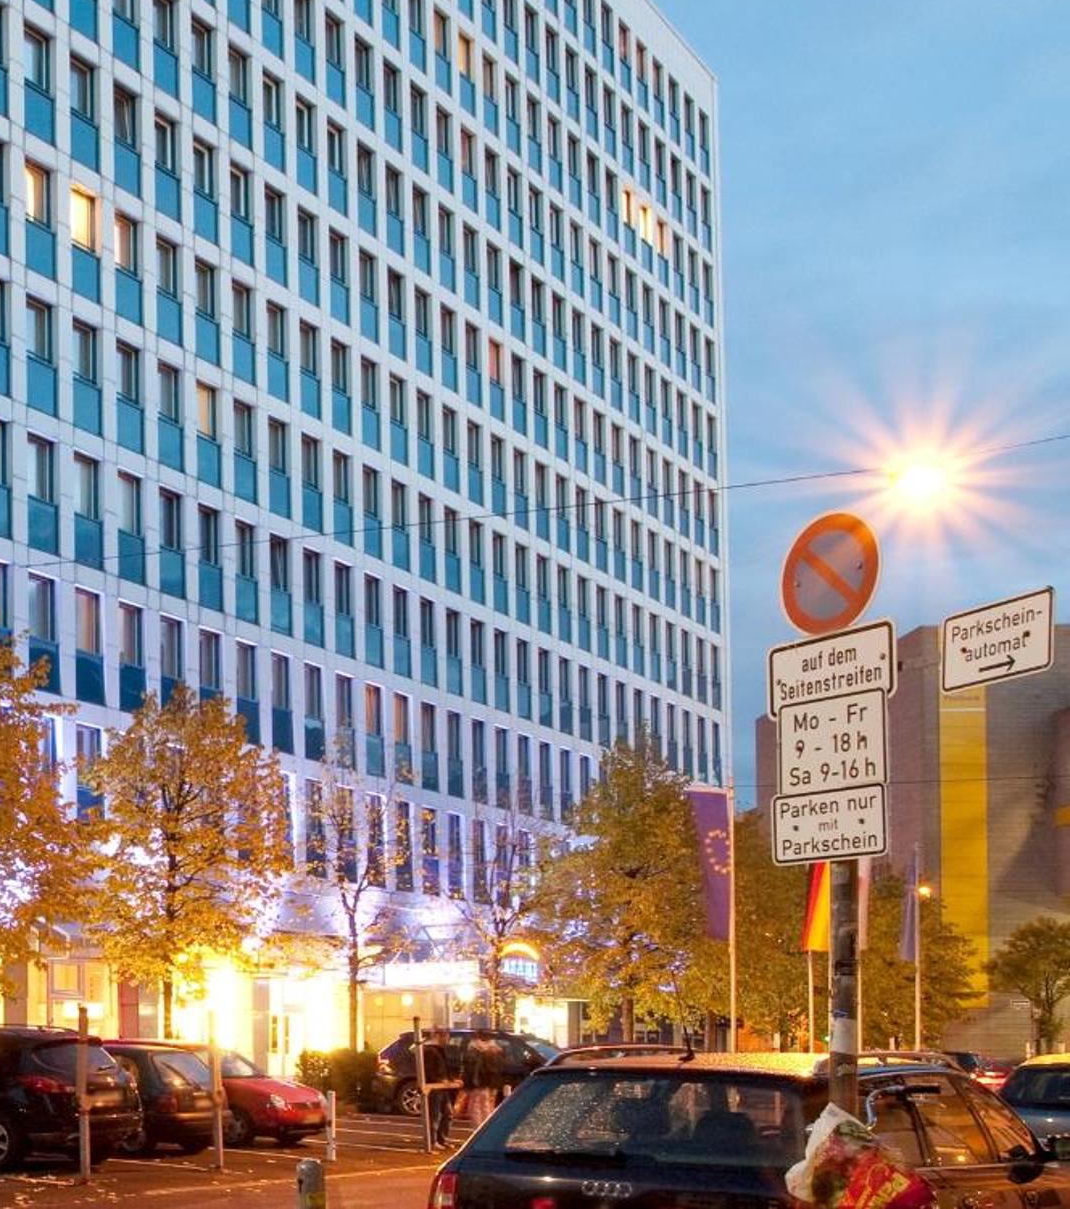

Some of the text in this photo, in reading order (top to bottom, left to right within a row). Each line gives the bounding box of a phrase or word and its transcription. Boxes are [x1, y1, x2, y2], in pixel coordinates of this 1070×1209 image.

[951, 607, 1043, 643] Parkschein-
[802, 646, 857, 672] auf dem
[965, 634, 1028, 662] automat
[779, 665, 883, 701] Seitenstreifen
[793, 712, 820, 732] Mo
[847, 702, 868, 724] Fr
[795, 739, 805, 760] 9
[832, 732, 851, 753] 18
[856, 730, 868, 750] h
[789, 767, 811, 786] Sa
[865, 756, 876, 777] h
[779, 795, 877, 819] Parken nur
[818, 818, 839, 831] mit
[782, 831, 878, 856] Parkschein
